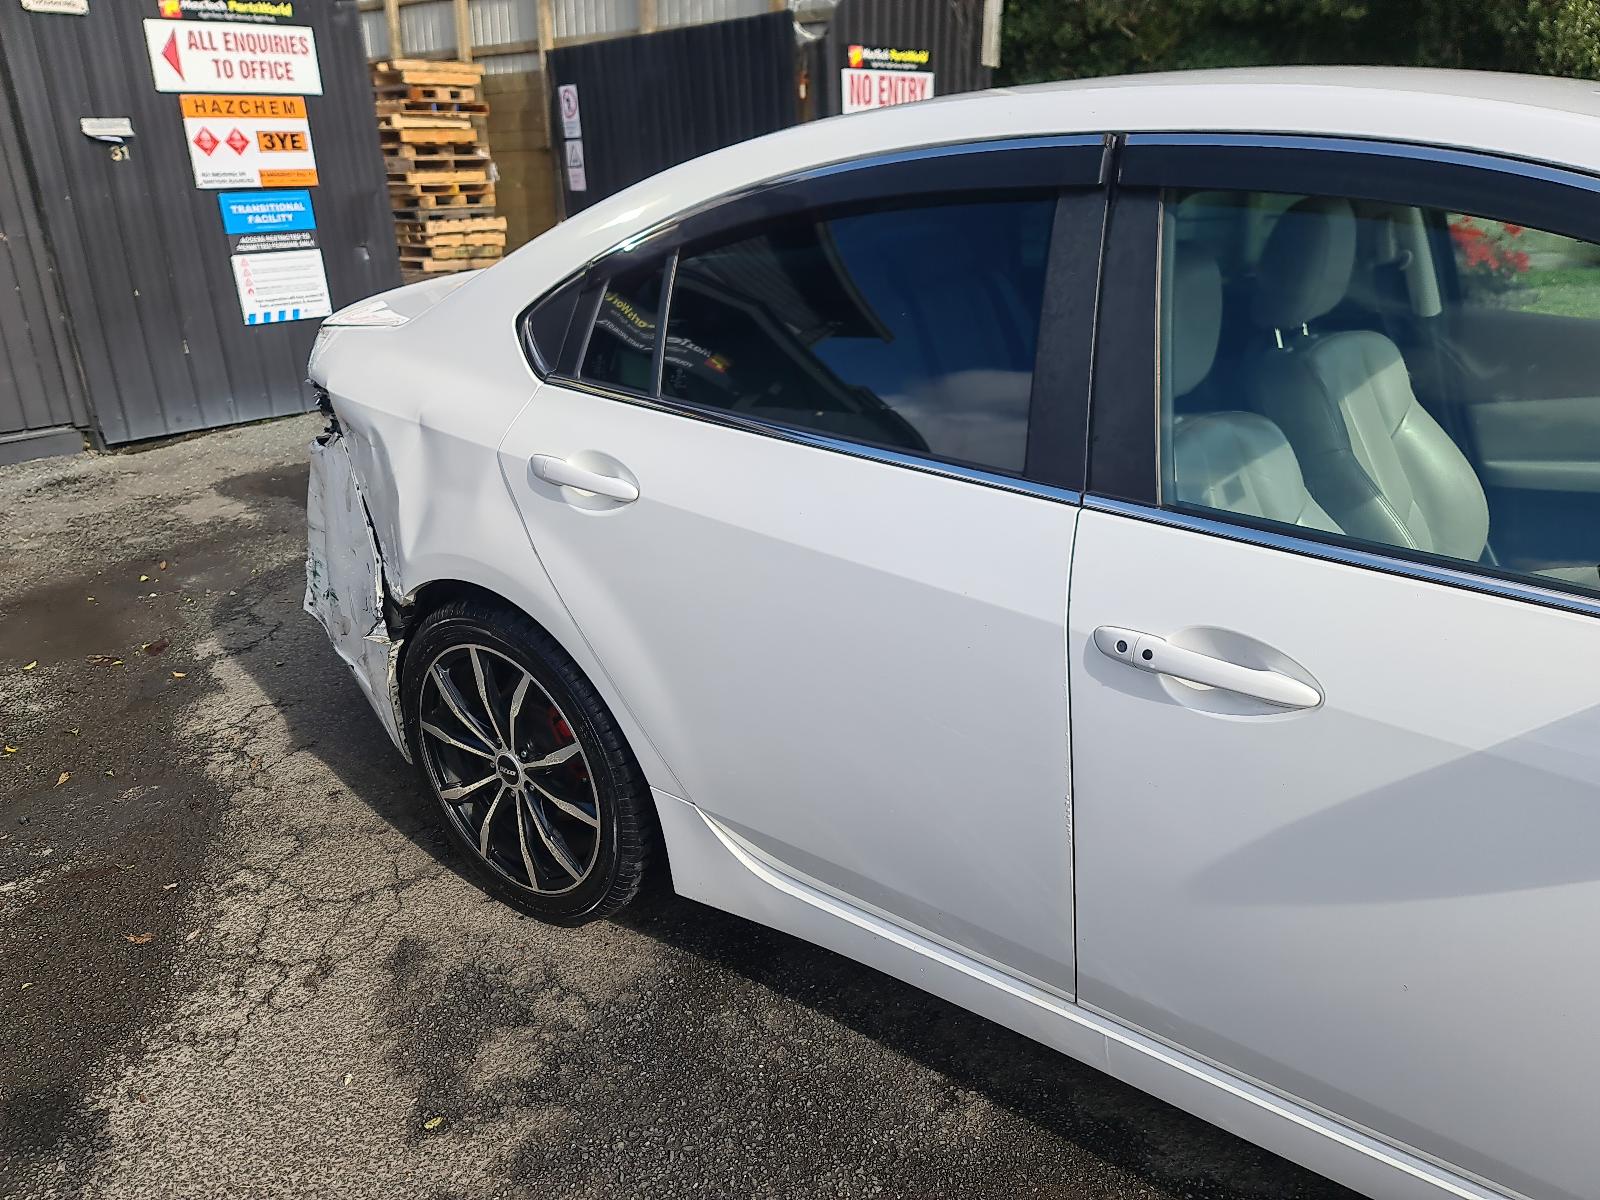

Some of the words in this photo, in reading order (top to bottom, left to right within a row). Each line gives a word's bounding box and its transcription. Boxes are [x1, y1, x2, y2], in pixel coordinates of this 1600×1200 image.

[188, 30, 218, 51] ALL
[223, 31, 309, 55] ENQUIRIES
[212, 59, 234, 78] TO
[240, 60, 295, 81] OFFICE
[849, 74, 872, 106] NO
[879, 75, 928, 107] ENTRY
[195, 100, 296, 114] HAZCHEM
[263, 133, 302, 150] 3YE
[230, 201, 306, 214] TRANSITIONAL
[247, 213, 293, 224] FACILITY
